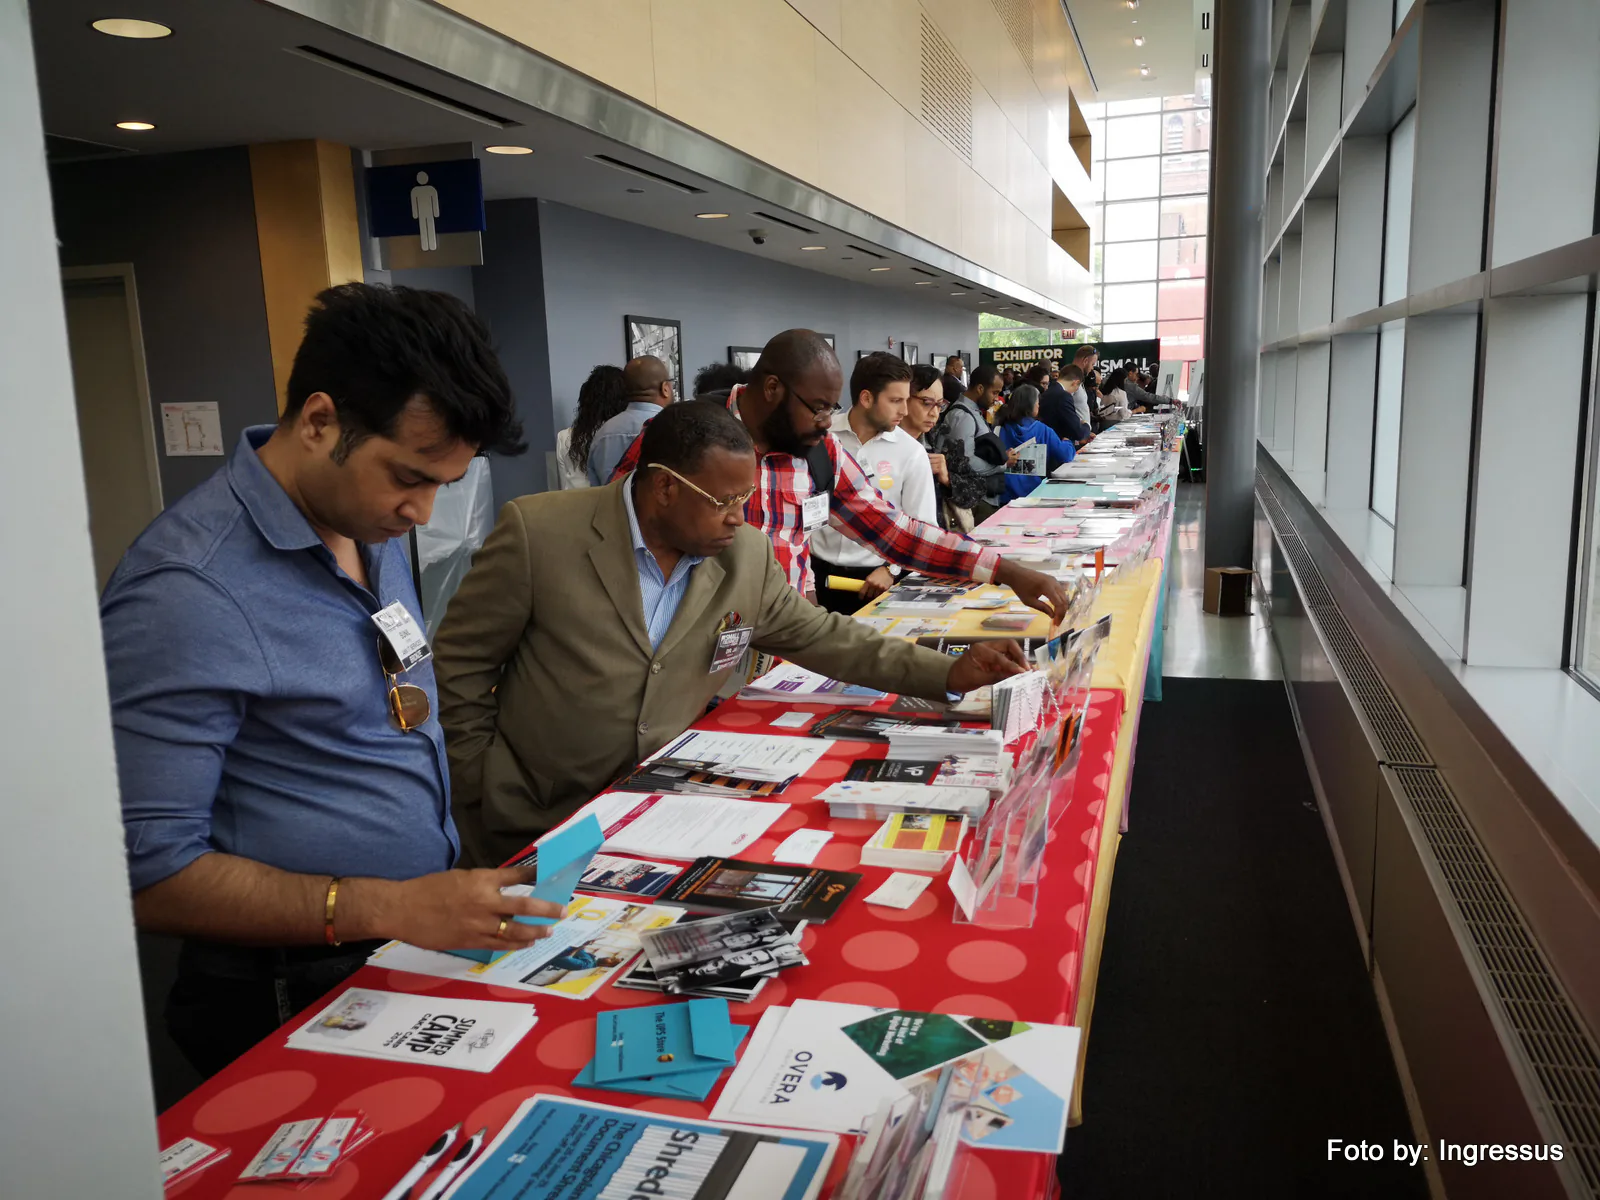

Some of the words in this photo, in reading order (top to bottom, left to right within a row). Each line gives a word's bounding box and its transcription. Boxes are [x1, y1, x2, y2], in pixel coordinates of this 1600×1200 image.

[993, 348, 1063, 361] EXHIBITOR
[997, 361, 1059, 373] SERVS
[655, 1011, 665, 1022] The
[406, 1014, 458, 1053] CAMP
[427, 1018, 476, 1056] SUMMER
[656, 1023, 666, 1035] UPS
[656, 1036, 667, 1053] Store
[770, 1051, 813, 1104] OVERA
[611, 1121, 636, 1141] The
[567, 1118, 619, 1174] Document
